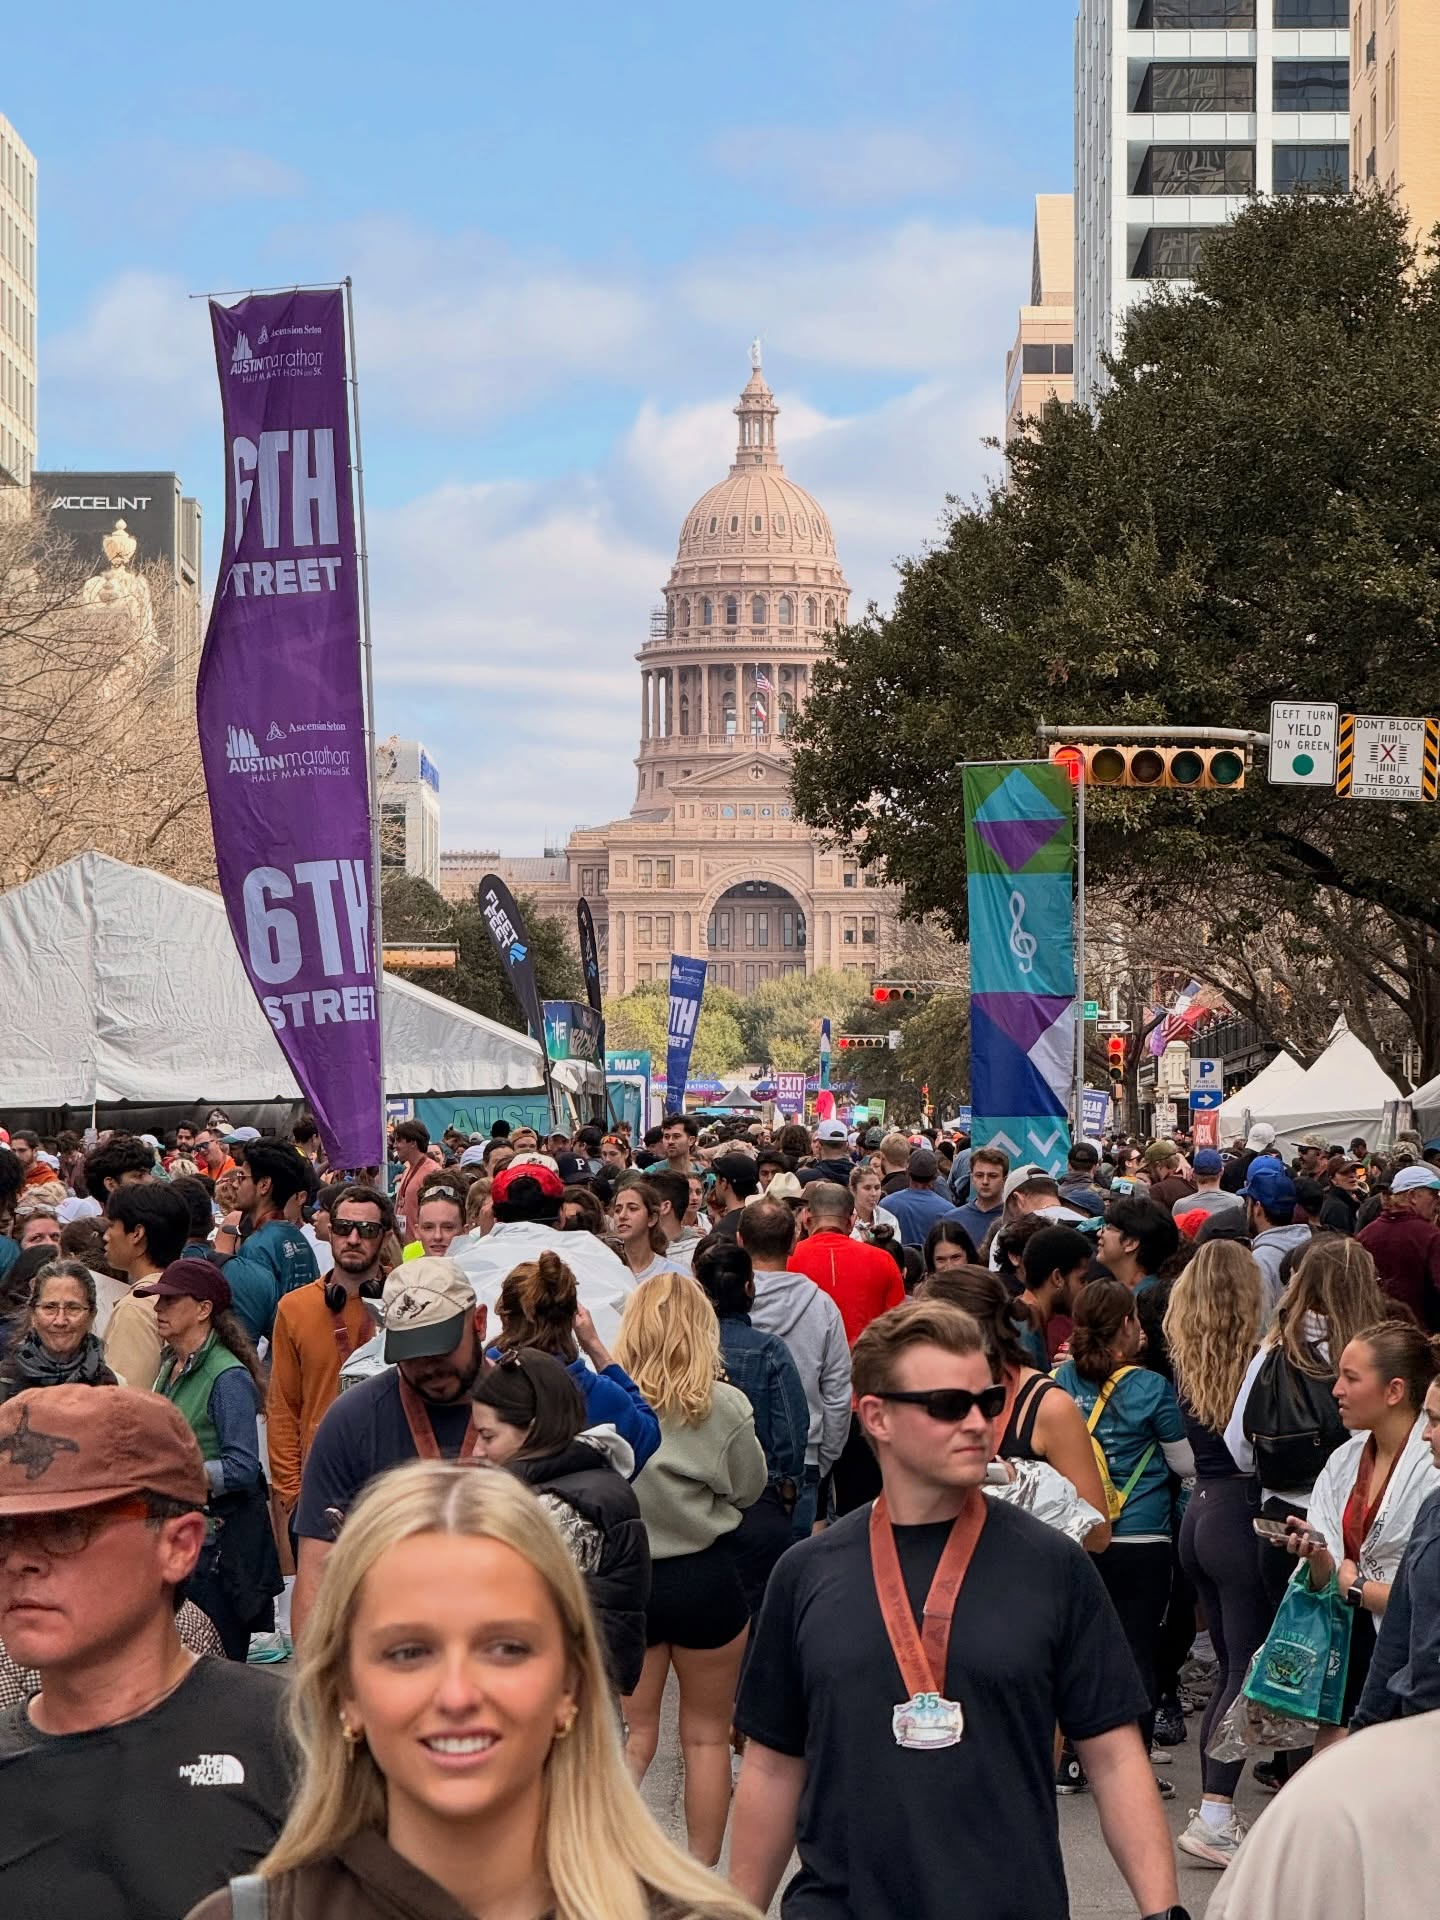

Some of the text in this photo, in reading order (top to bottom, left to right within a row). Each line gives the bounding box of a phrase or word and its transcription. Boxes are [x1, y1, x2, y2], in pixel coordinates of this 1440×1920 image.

[313, 367, 322, 376] 5K
[232, 428, 339, 552] 6TH
[51, 496, 152, 510] ACCELINT
[223, 556, 342, 598] TREET
[1276, 709, 1333, 720] LEFT TURN
[1288, 723, 1321, 737] YIELD
[1389, 720, 1424, 732] BLOCK
[1277, 740, 1330, 751] ON GREEN
[251, 771, 278, 783] HALF
[281, 766, 332, 779] MARATHON
[341, 767, 351, 776] 5K
[1365, 774, 1411, 785] THE BOX
[1353, 786, 1420, 798] UP TO $500 FINE
[243, 859, 371, 985] 6TH
[485, 889, 518, 943] FLEET
[484, 905, 510, 948] FEET
[263, 986, 376, 1030] STREET
[669, 995, 698, 1035] TH
[614, 1058, 640, 1071] MAP
[1200, 1061, 1214, 1078] P
[778, 1076, 804, 1091] EXIT
[778, 1091, 802, 1100] ONLY
[1083, 1100, 1102, 1112] GEAR
[452, 1105, 548, 1134] AUST
[575, 1158, 585, 1170] P
[915, 1694, 939, 1711] 35
[198, 1754, 223, 1766] THE
[179, 1764, 223, 1778] NORTH
[190, 1774, 223, 1786] FACE
